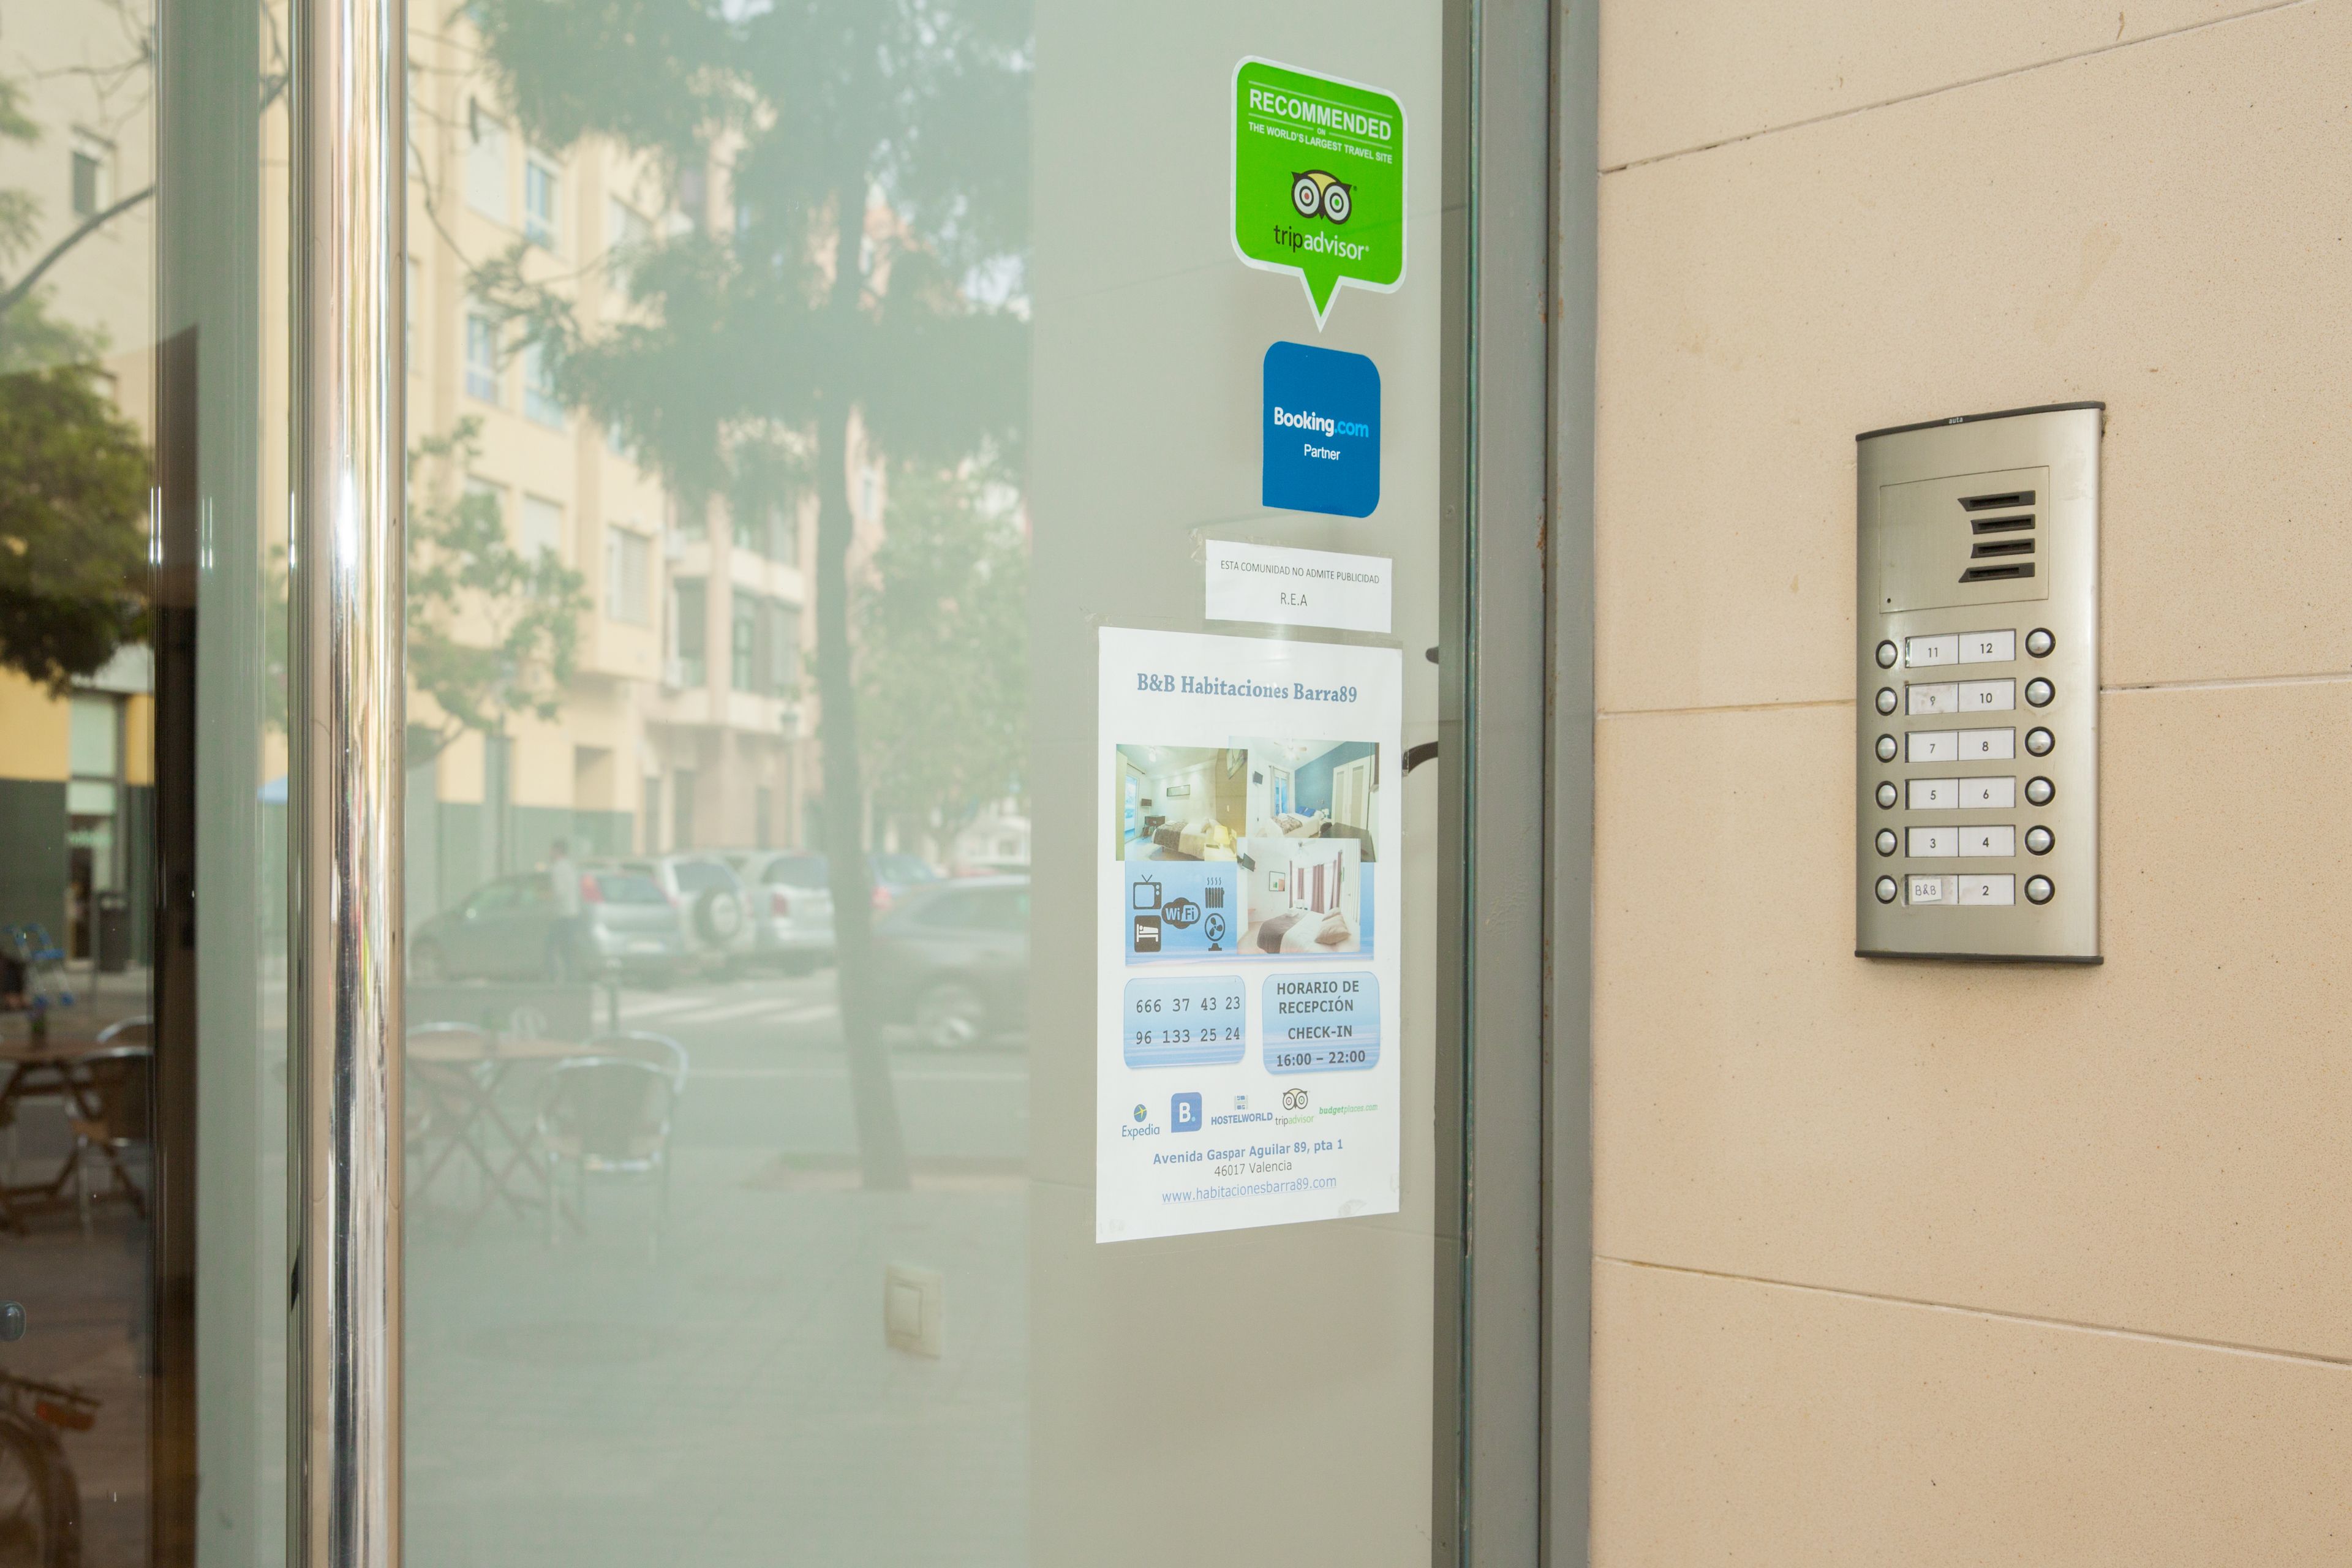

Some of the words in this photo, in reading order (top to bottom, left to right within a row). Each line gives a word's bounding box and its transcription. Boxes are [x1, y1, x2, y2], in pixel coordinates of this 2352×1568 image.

[1250, 88, 1392, 141] RECOMMENDED
[1317, 127, 1326, 136] ON
[1248, 122, 1265, 134] THE
[1267, 126, 1304, 143] WORLD'S
[1305, 135, 1343, 152] LARGEST
[1344, 144, 1374, 159] TRAVEL
[1376, 151, 1393, 164] SITE
[1274, 406, 1370, 438] Booking.com
[1304, 443, 1341, 461] Partner
[1221, 560, 1239, 570] ESTA
[1241, 562, 1291, 575] COMUNIDAD
[1292, 567, 1304, 576] NO
[1306, 568, 1335, 579] ADMITE
[1336, 571, 1379, 584] PUBLICIDAD
[1280, 592, 1308, 606] R.E.A
[1928, 647, 1938, 658] 11
[1980, 643, 1992, 654] 12
[1137, 673, 1175, 692] B&B
[1181, 676, 1289, 699] Habitaciones
[1293, 682, 1357, 703] Barra89
[1930, 696, 1936, 706] 9
[1980, 693, 1992, 704] 10
[1930, 744, 1936, 753] 7
[1982, 741, 1989, 752] 8
[1931, 790, 1936, 800] 5
[1983, 789, 1989, 799] 6
[1930, 839, 1936, 848] 3
[1983, 837, 1989, 847] 4
[1915, 884, 1936, 895] B&B
[1983, 886, 1989, 895] 2
[1277, 981, 1338, 995] HORARIO
[1343, 980, 1359, 992] DE
[1136, 999, 1161, 1013] 666
[1172, 998, 1190, 1012] 37
[1200, 997, 1217, 1011] 43
[1226, 996, 1240, 1010] 23
[1279, 995, 1354, 1014] RECEPCIÓN
[1136, 1030, 1152, 1044] 96
[1163, 1029, 1190, 1044] 133
[1200, 1028, 1217, 1042] 25
[1226, 1027, 1240, 1041] 24
[1288, 1025, 1352, 1039] CHECK-IN
[1276, 1053, 1312, 1067] 16:00
[1329, 1050, 1365, 1064] 22:00
[1319, 1104, 1378, 1115] budgetplaces.com
[1211, 1112, 1273, 1125] HOSTELWORLD
[1275, 1114, 1314, 1127] tripadvisor
[1121, 1123, 1160, 1140] Expedia
[1153, 1150, 1203, 1164] Avenida
[1207, 1147, 1245, 1161] Gaspar
[1250, 1144, 1291, 1158] Aguilar
[1294, 1142, 1310, 1154] 89,
[1314, 1140, 1333, 1153] pta
[1337, 1139, 1343, 1150] 1
[1214, 1164, 1245, 1177] 46017
[1249, 1160, 1292, 1174] Valencia
[1162, 1177, 1336, 1203] www.habitacionesbarra89.com
